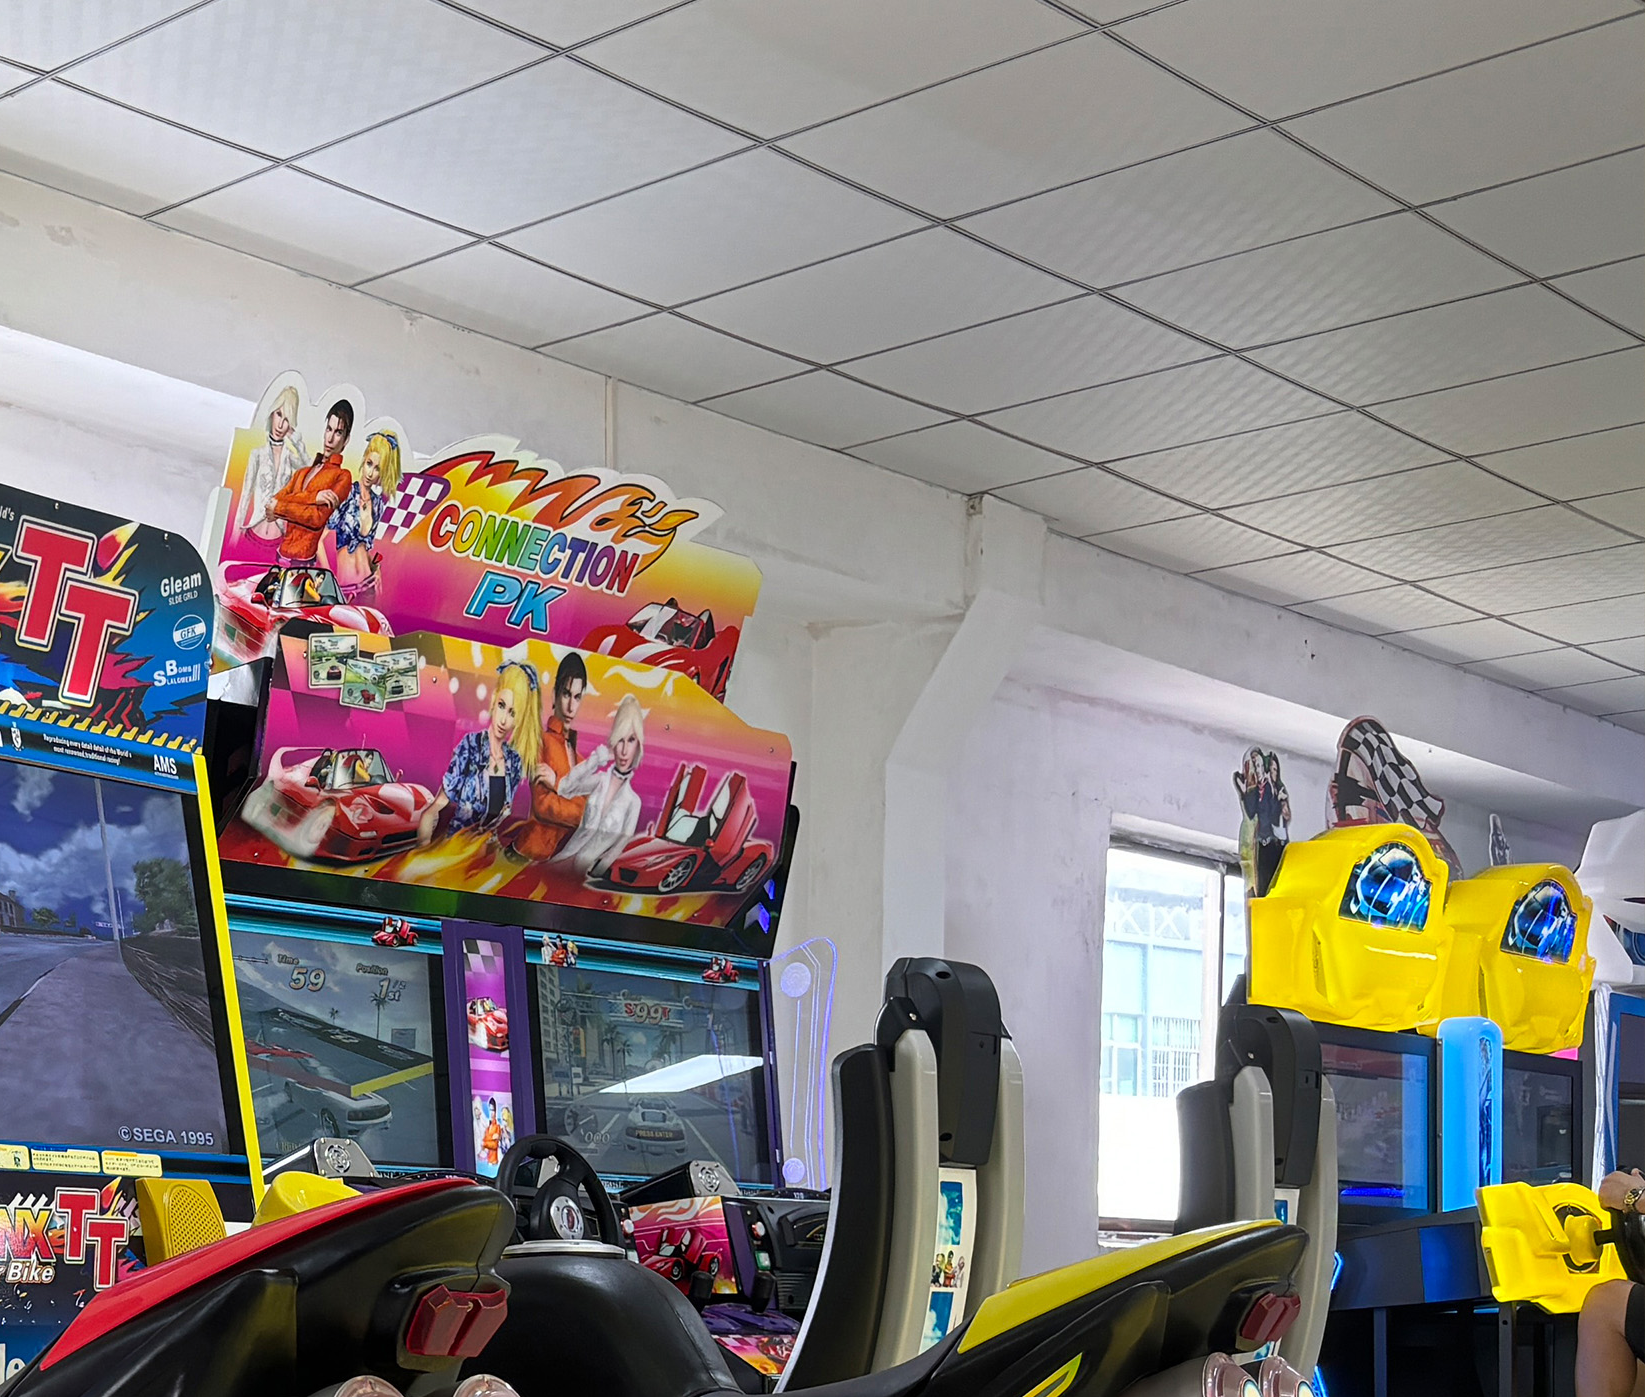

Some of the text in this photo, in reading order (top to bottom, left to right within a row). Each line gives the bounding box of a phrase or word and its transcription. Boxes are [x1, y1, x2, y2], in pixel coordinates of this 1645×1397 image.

[429, 502, 641, 596] CONNECTION
[161, 572, 202, 597] Gleam
[13, 515, 139, 707] TT
[464, 570, 567, 633] PK
[153, 754, 178, 776] AMS
[277, 953, 300, 966] Time
[289, 967, 326, 992] 59
[180, 1130, 214, 1146] 1995
[5, 1260, 55, 1285] Bike
